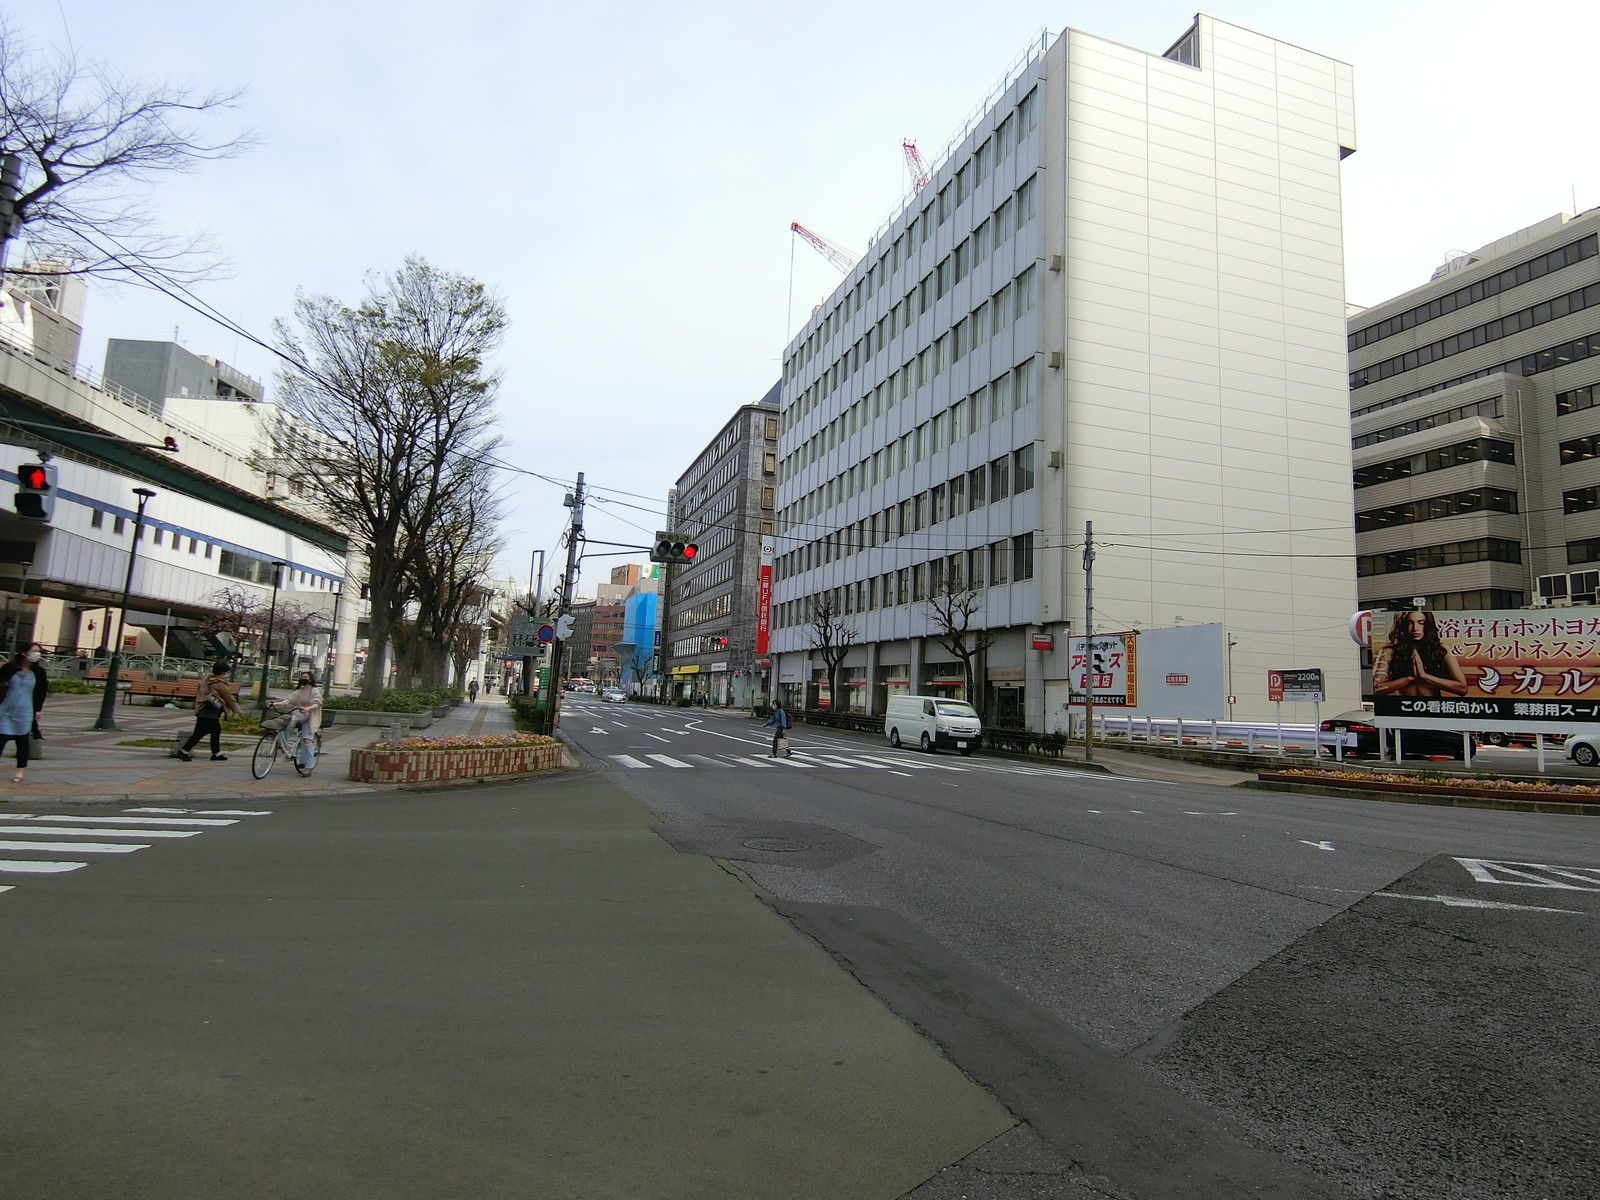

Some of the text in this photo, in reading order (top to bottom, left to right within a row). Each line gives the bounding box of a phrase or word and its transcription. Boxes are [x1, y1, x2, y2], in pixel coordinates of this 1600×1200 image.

[760, 575, 770, 632] 三菱UFJ信託銀行
[1127, 634, 1135, 704] 大型駐車場完備
[1451, 640, 1600, 660] &フィットネスジ
[1400, 700, 1499, 714] この看板向かい
